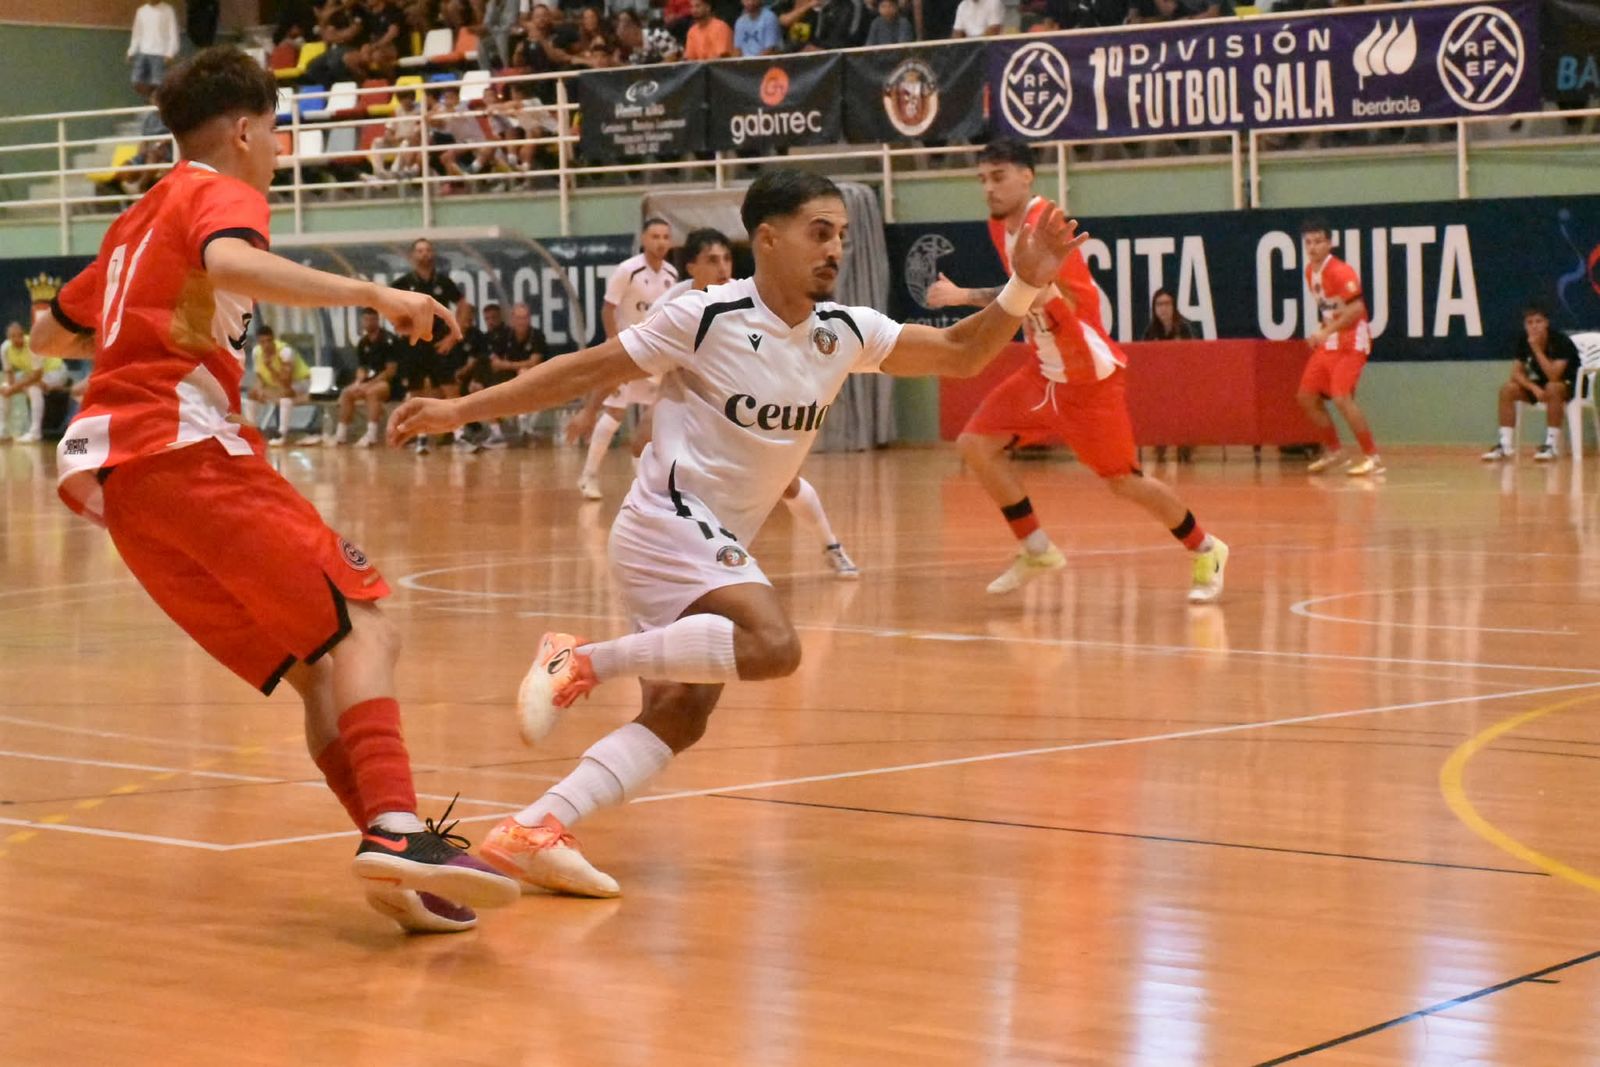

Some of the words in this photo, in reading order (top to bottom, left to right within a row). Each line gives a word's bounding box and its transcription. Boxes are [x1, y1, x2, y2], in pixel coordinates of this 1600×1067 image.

[1129, 24, 1330, 66] DIVISIÓN
[1464, 40, 1497, 57] RF
[1466, 60, 1497, 77] EF
[1023, 72, 1049, 88] RF
[1023, 91, 1050, 105] EF
[1128, 62, 1244, 128] FÚTBOL
[1253, 60, 1334, 122] SALA
[1352, 96, 1421, 116] Iberdrola
